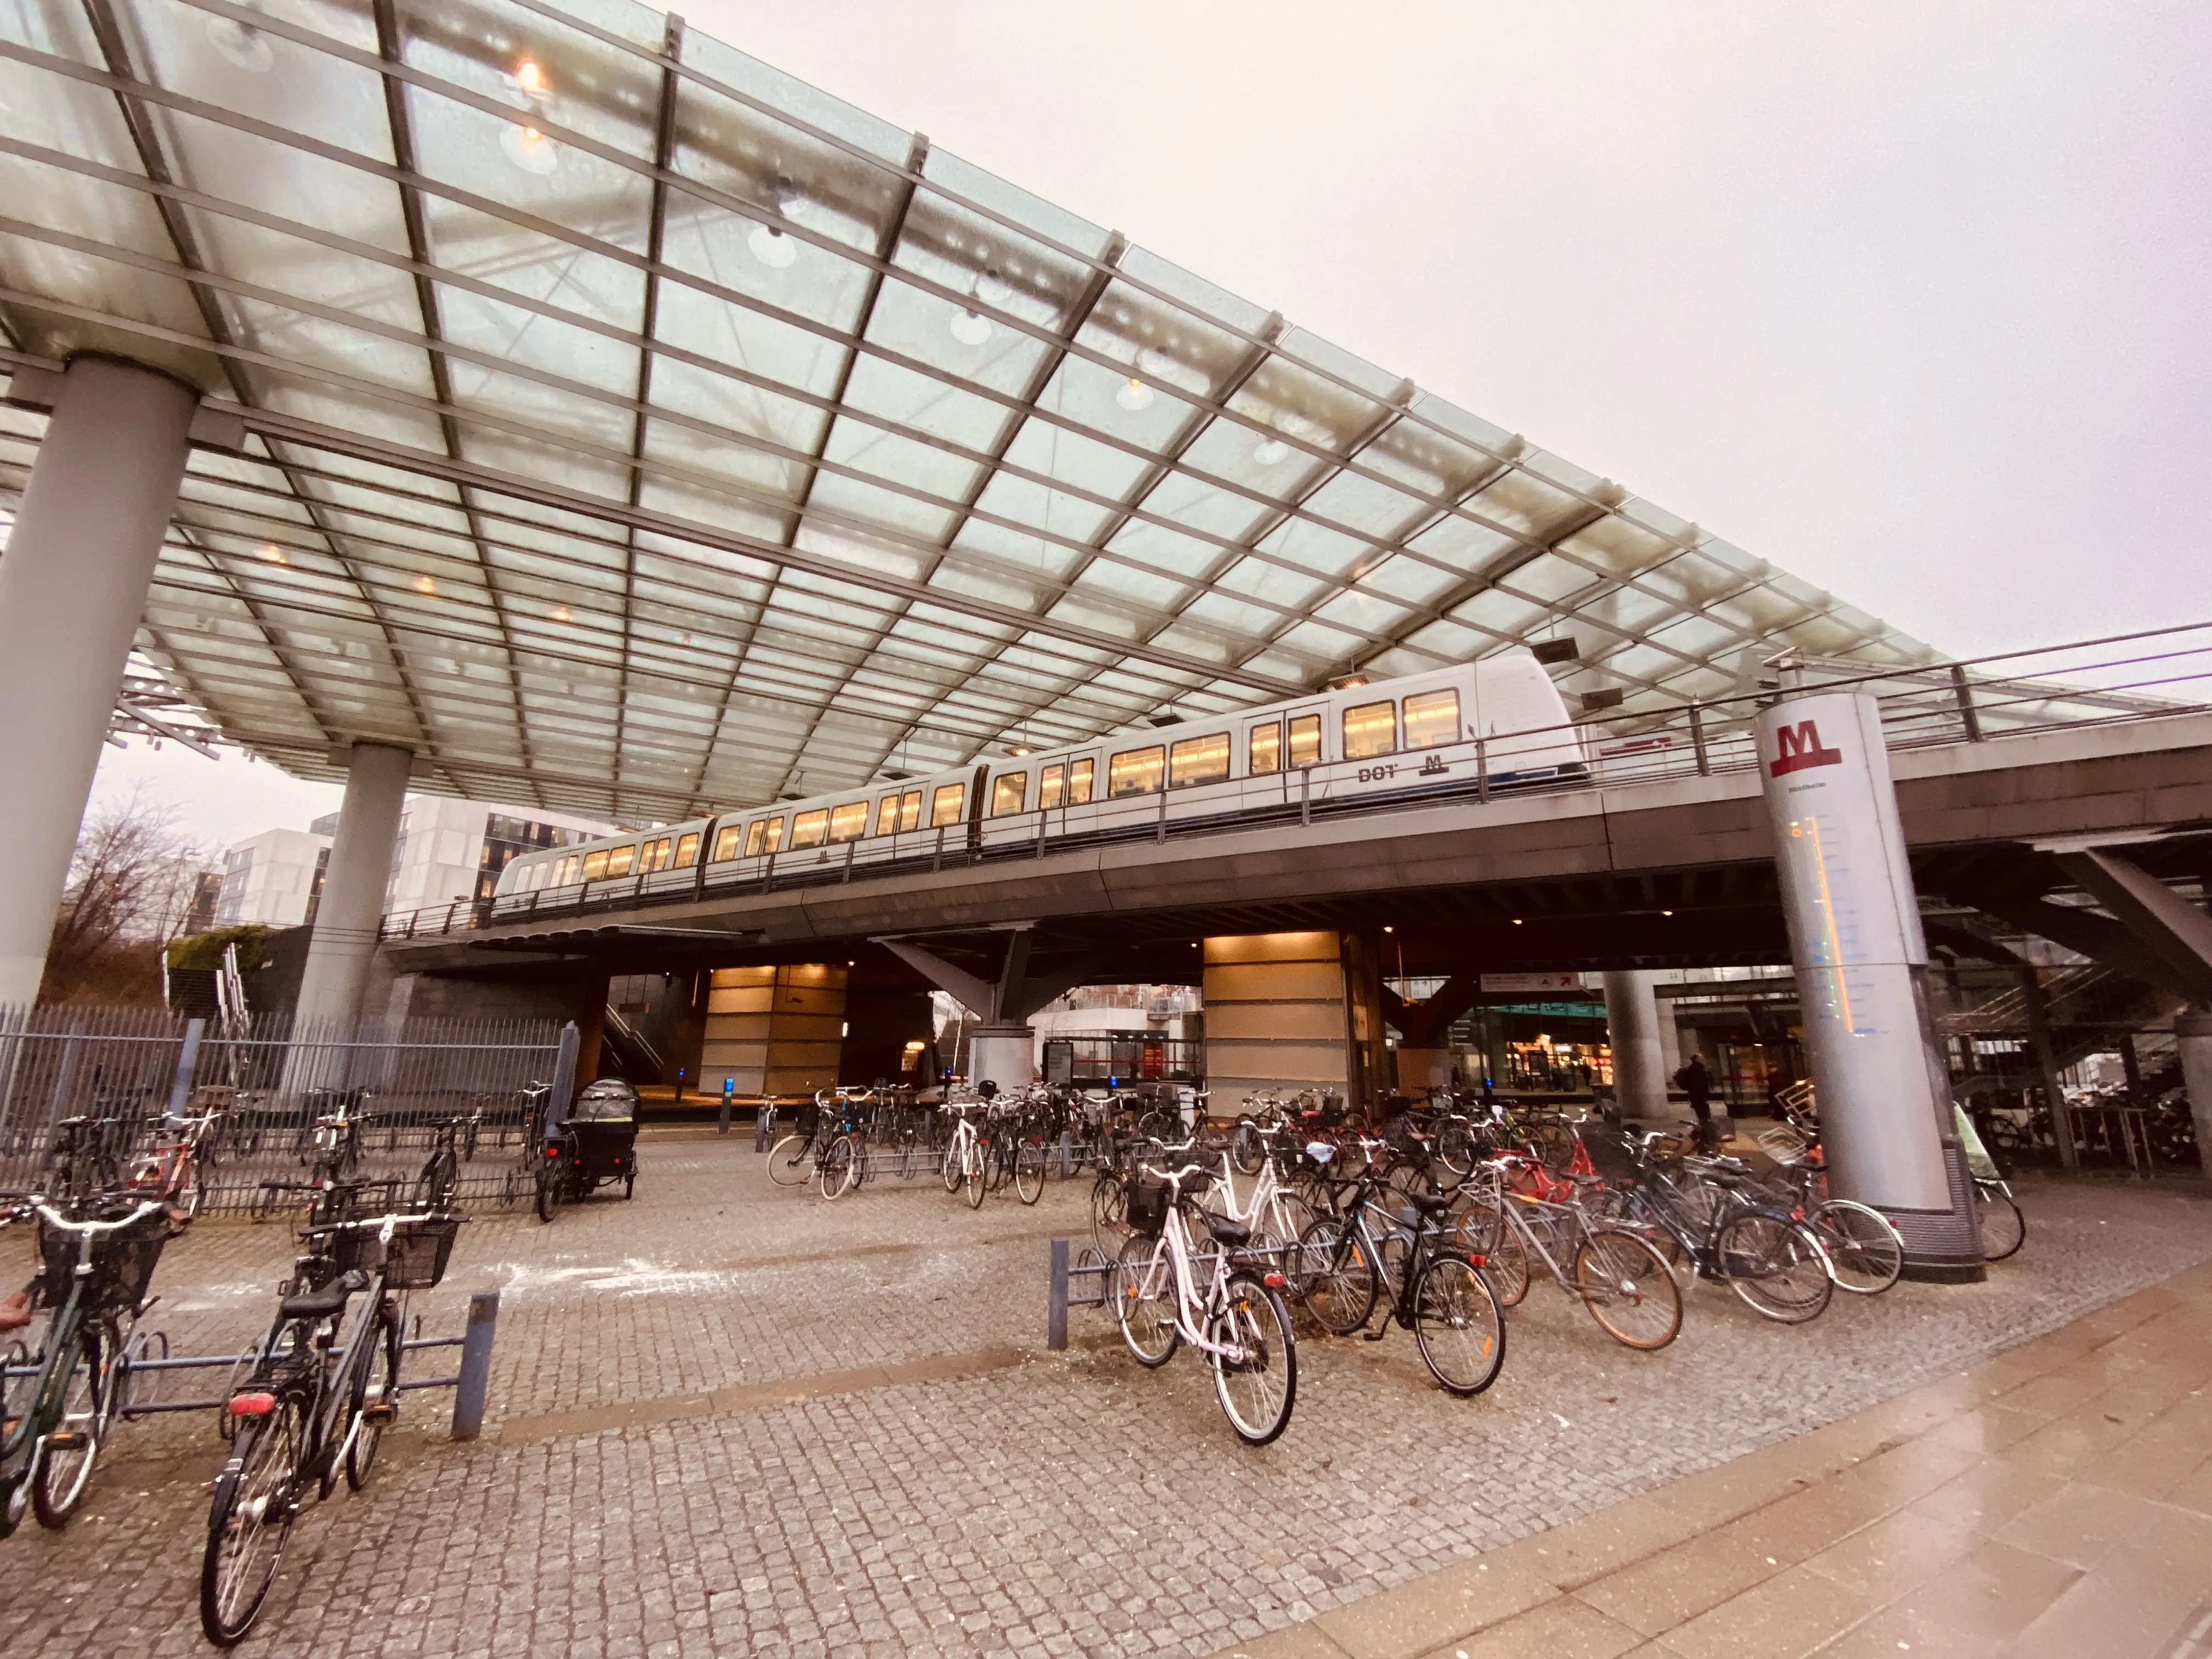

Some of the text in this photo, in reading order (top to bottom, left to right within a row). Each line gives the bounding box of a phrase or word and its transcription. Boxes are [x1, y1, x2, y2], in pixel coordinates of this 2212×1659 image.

[1770, 720, 1842, 778] M
[1358, 764, 1394, 782] DOT
[1419, 754, 1449, 776] M
